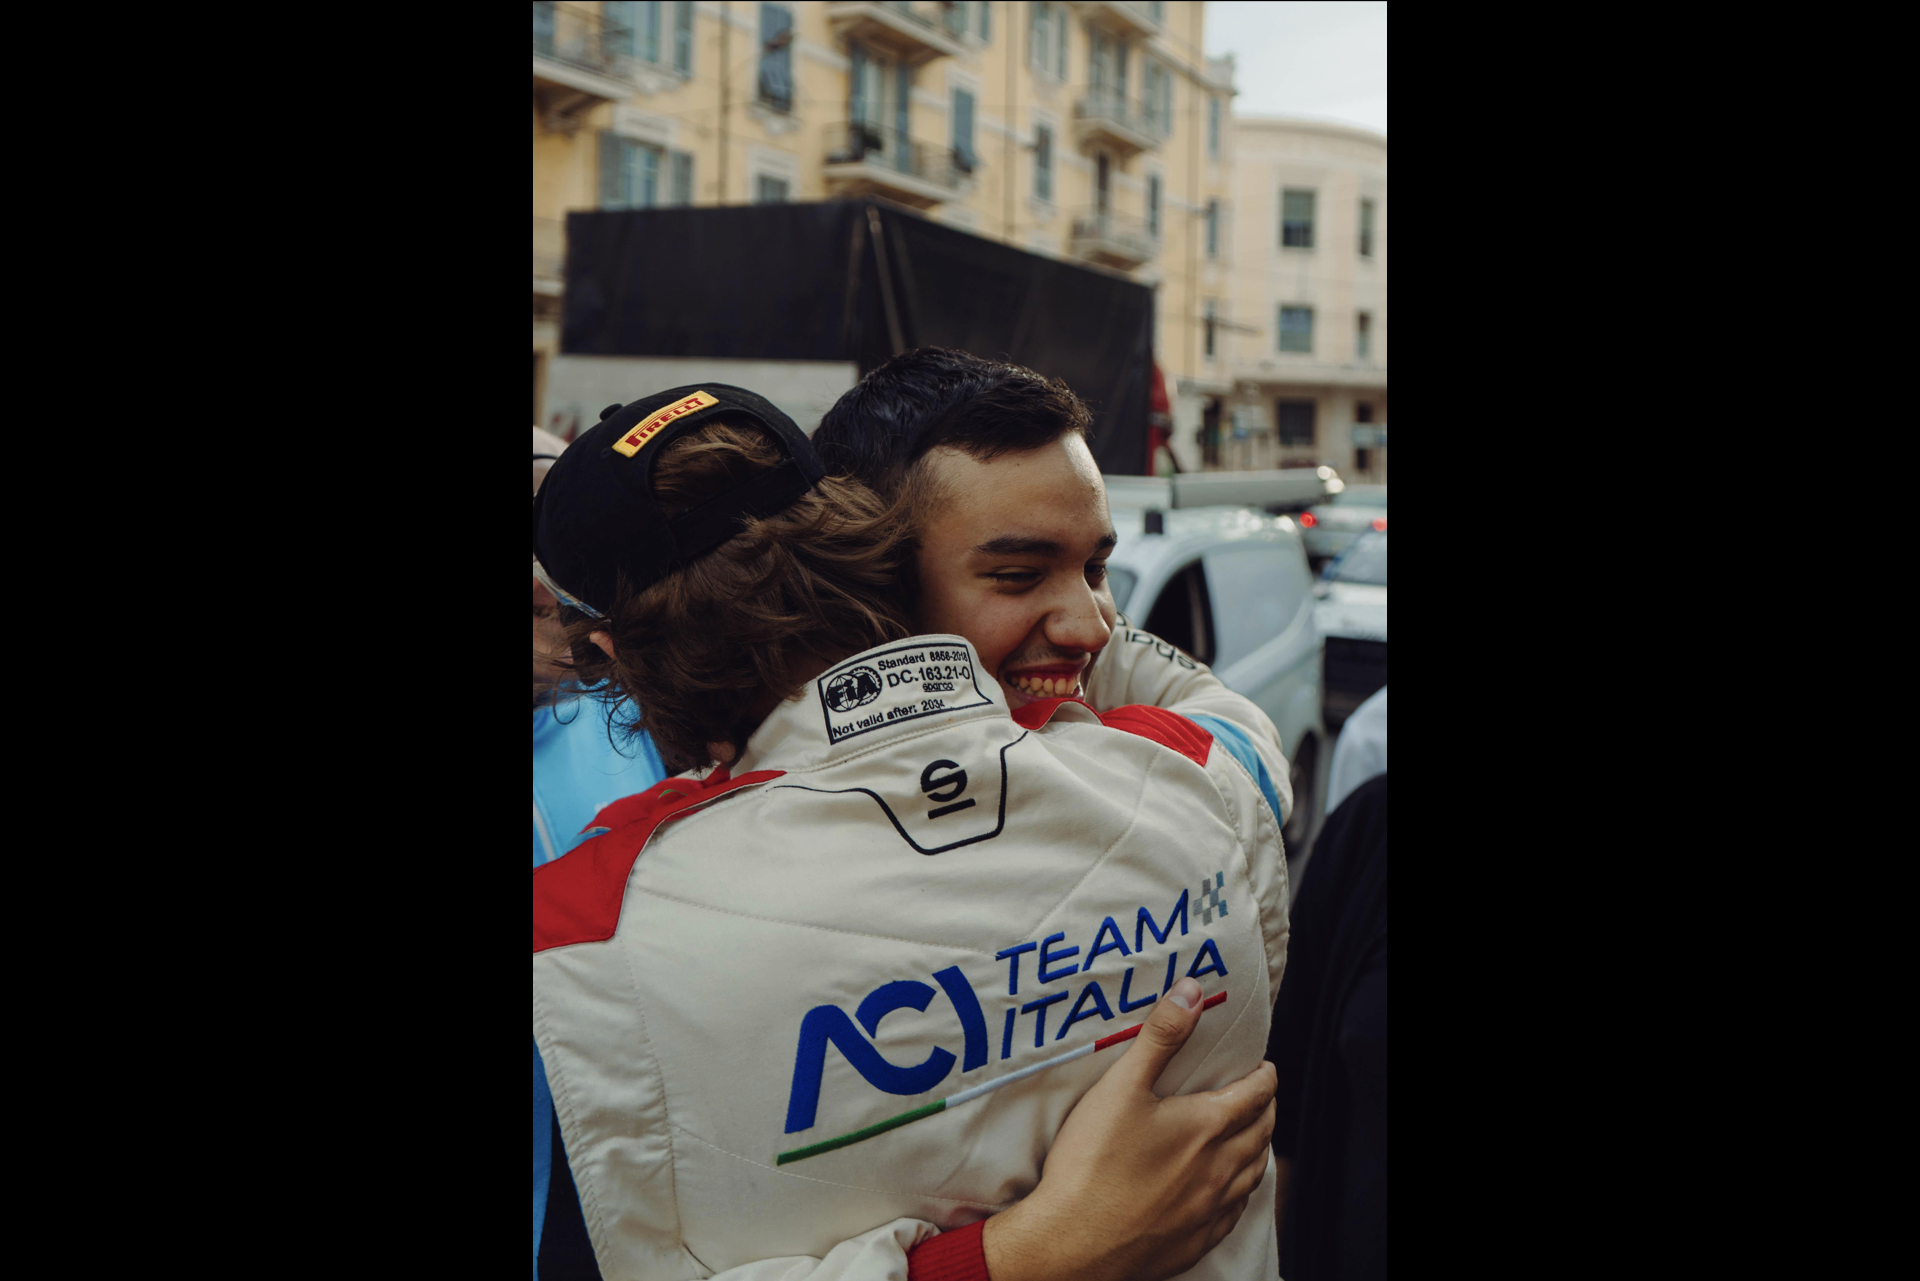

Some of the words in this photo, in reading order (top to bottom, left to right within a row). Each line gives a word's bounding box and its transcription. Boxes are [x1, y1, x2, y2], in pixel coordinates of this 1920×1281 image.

[625, 397, 704, 448] PIRELLI
[877, 652, 926, 671] Standard
[929, 650, 968, 662] 8856-2018
[922, 682, 954, 691] sparco
[832, 722, 855, 738] Not
[857, 712, 885, 728] valid
[887, 705, 917, 719] after:
[996, 889, 1189, 996] TEAM
[784, 965, 988, 1134] ACI
[1000, 939, 1228, 1060] ITALIA
